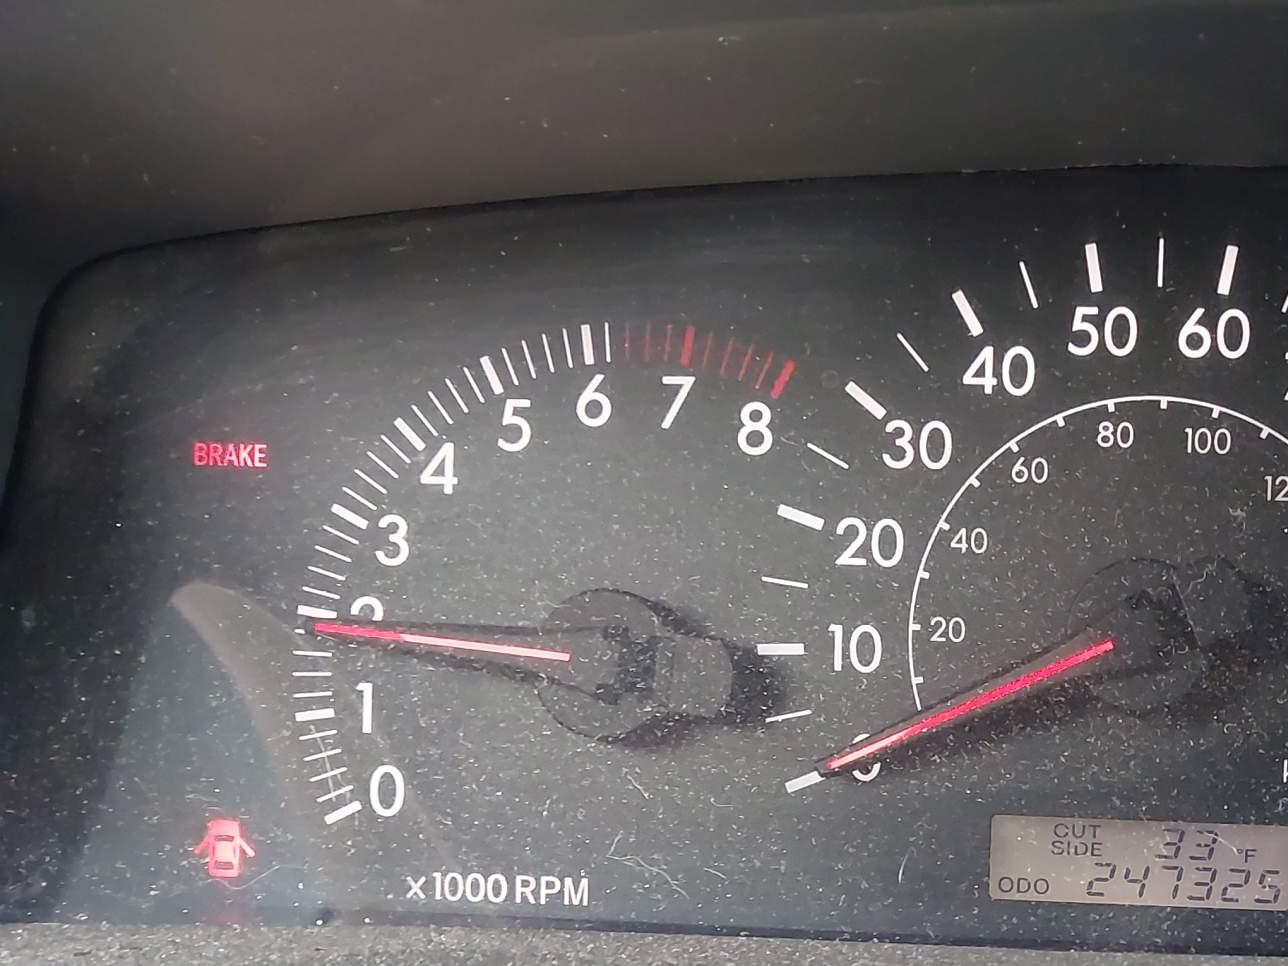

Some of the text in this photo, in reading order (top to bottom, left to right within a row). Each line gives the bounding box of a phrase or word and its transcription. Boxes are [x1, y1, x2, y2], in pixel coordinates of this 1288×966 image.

[1068, 307, 1137, 356] 50
[1179, 308, 1250, 358] 60
[963, 346, 1035, 396] 40
[498, 399, 531, 451] 5
[576, 374, 611, 427] 6
[661, 376, 695, 429] 7
[738, 402, 772, 455] 8
[883, 420, 952, 469] 30
[1097, 422, 1133, 448] 80
[1185, 428, 1231, 454] 100
[193, 442, 268, 468] BRAKE
[420, 444, 458, 494] 4
[1012, 457, 1048, 483] 60
[375, 515, 409, 566] 3
[835, 518, 903, 567] 20
[951, 528, 987, 553] 40
[828, 624, 882, 673] 10
[931, 617, 965, 642] 20
[356, 683, 372, 733] 1
[370, 765, 404, 816] 0
[1050, 840, 1103, 857] SIDE
[1155, 828, 1218, 861] 33
[406, 872, 588, 906] x1000 RPM
[998, 862, 1281, 904] ODO 247325
